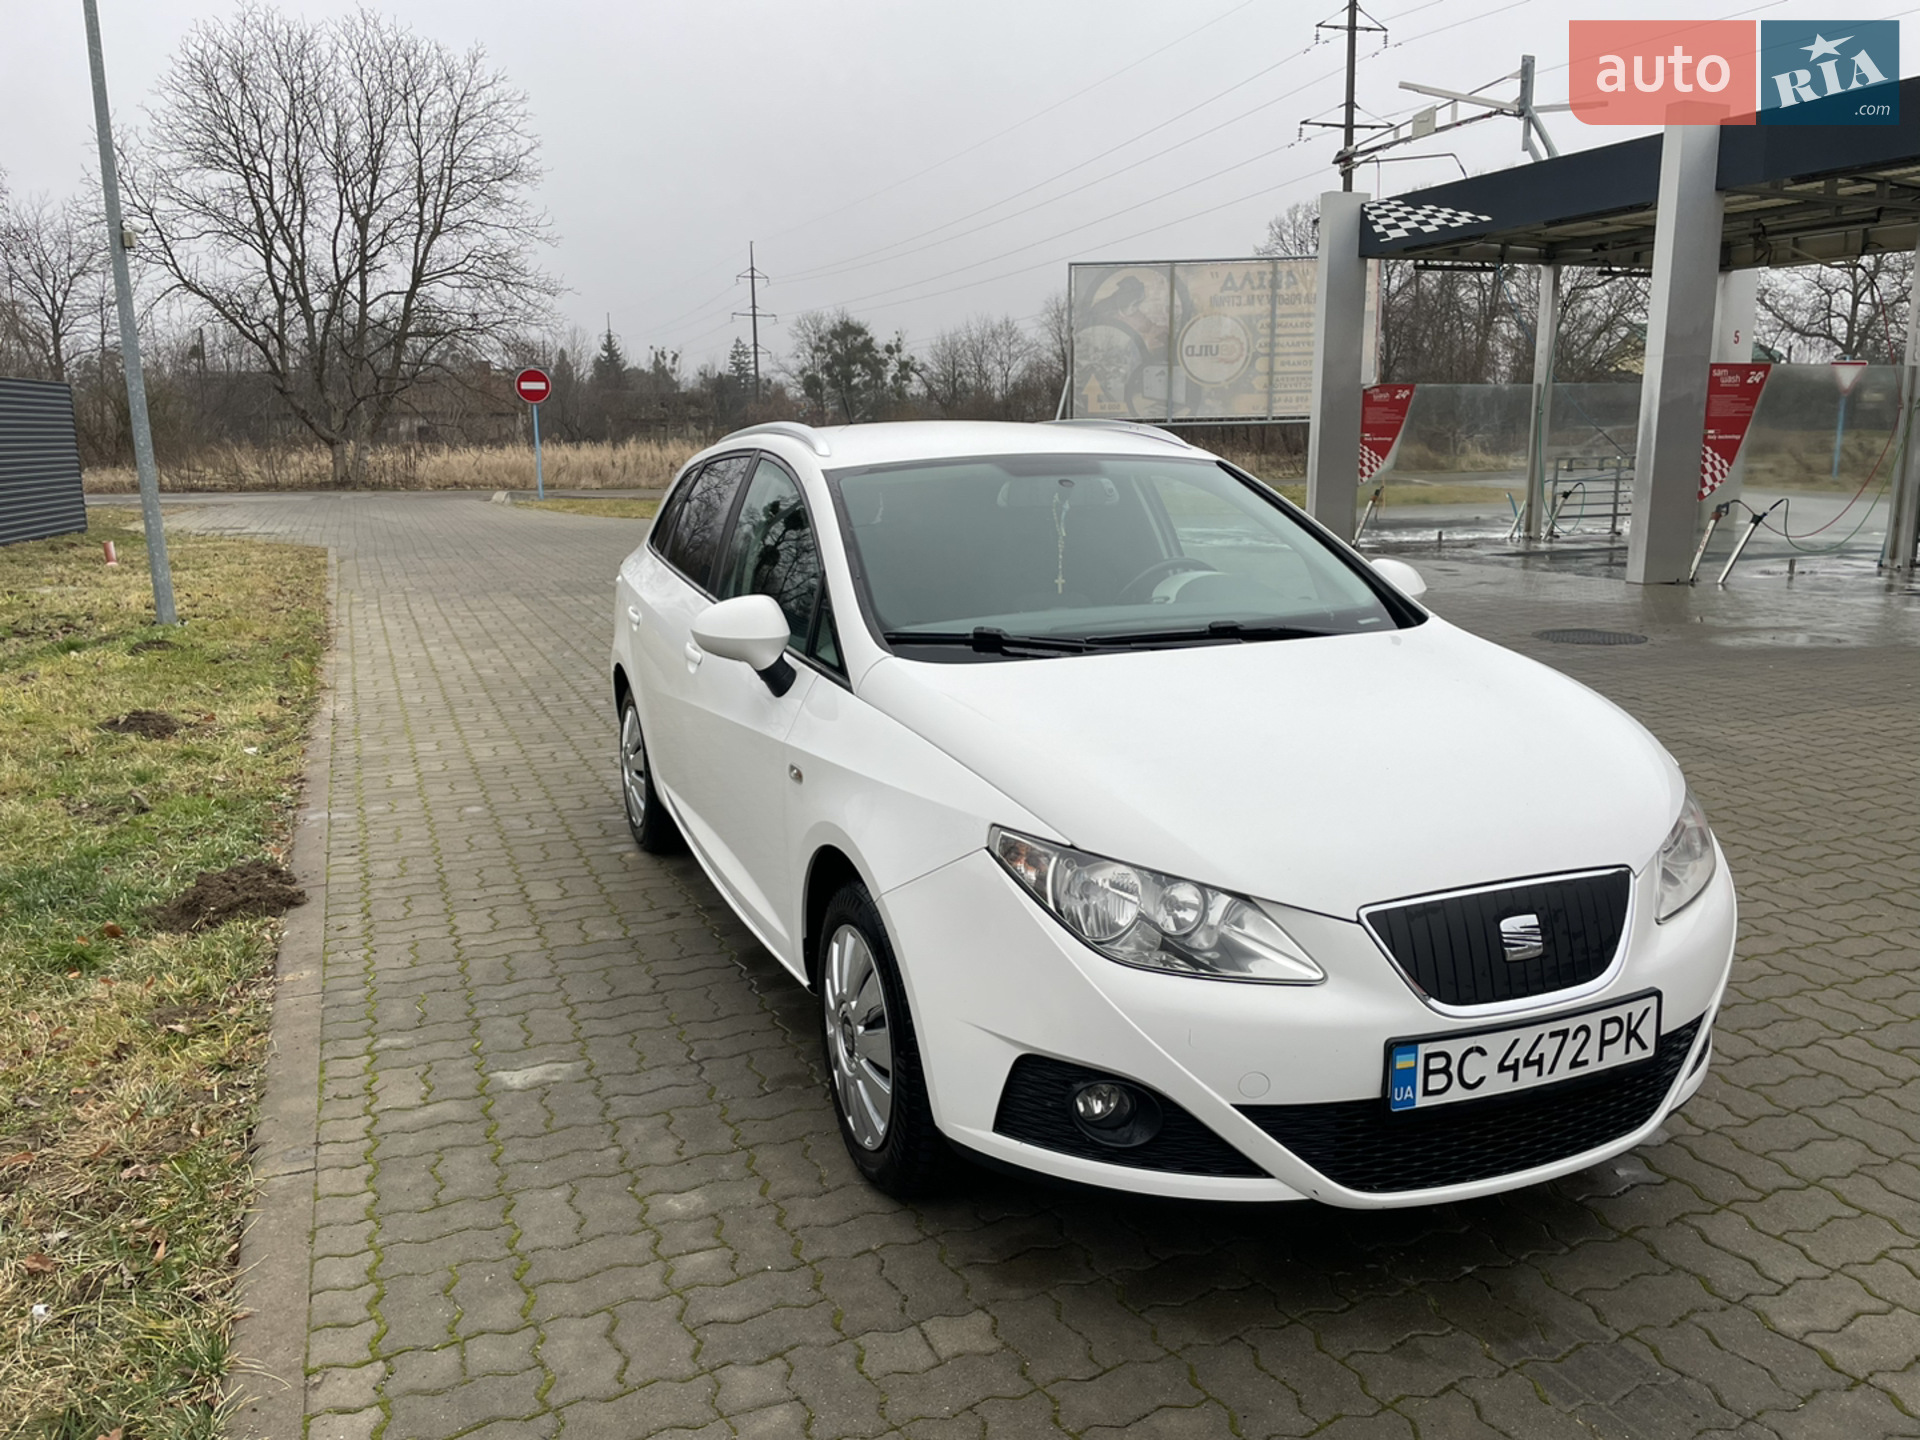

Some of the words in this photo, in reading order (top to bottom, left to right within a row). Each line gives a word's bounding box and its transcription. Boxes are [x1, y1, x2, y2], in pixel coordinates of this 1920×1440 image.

[1733, 329, 1740, 345] 5
[1421, 1044, 1489, 1097] BC
[1497, 1023, 1593, 1083] 4472
[1597, 1006, 1652, 1063] PK
[1393, 1085, 1414, 1102] UA
